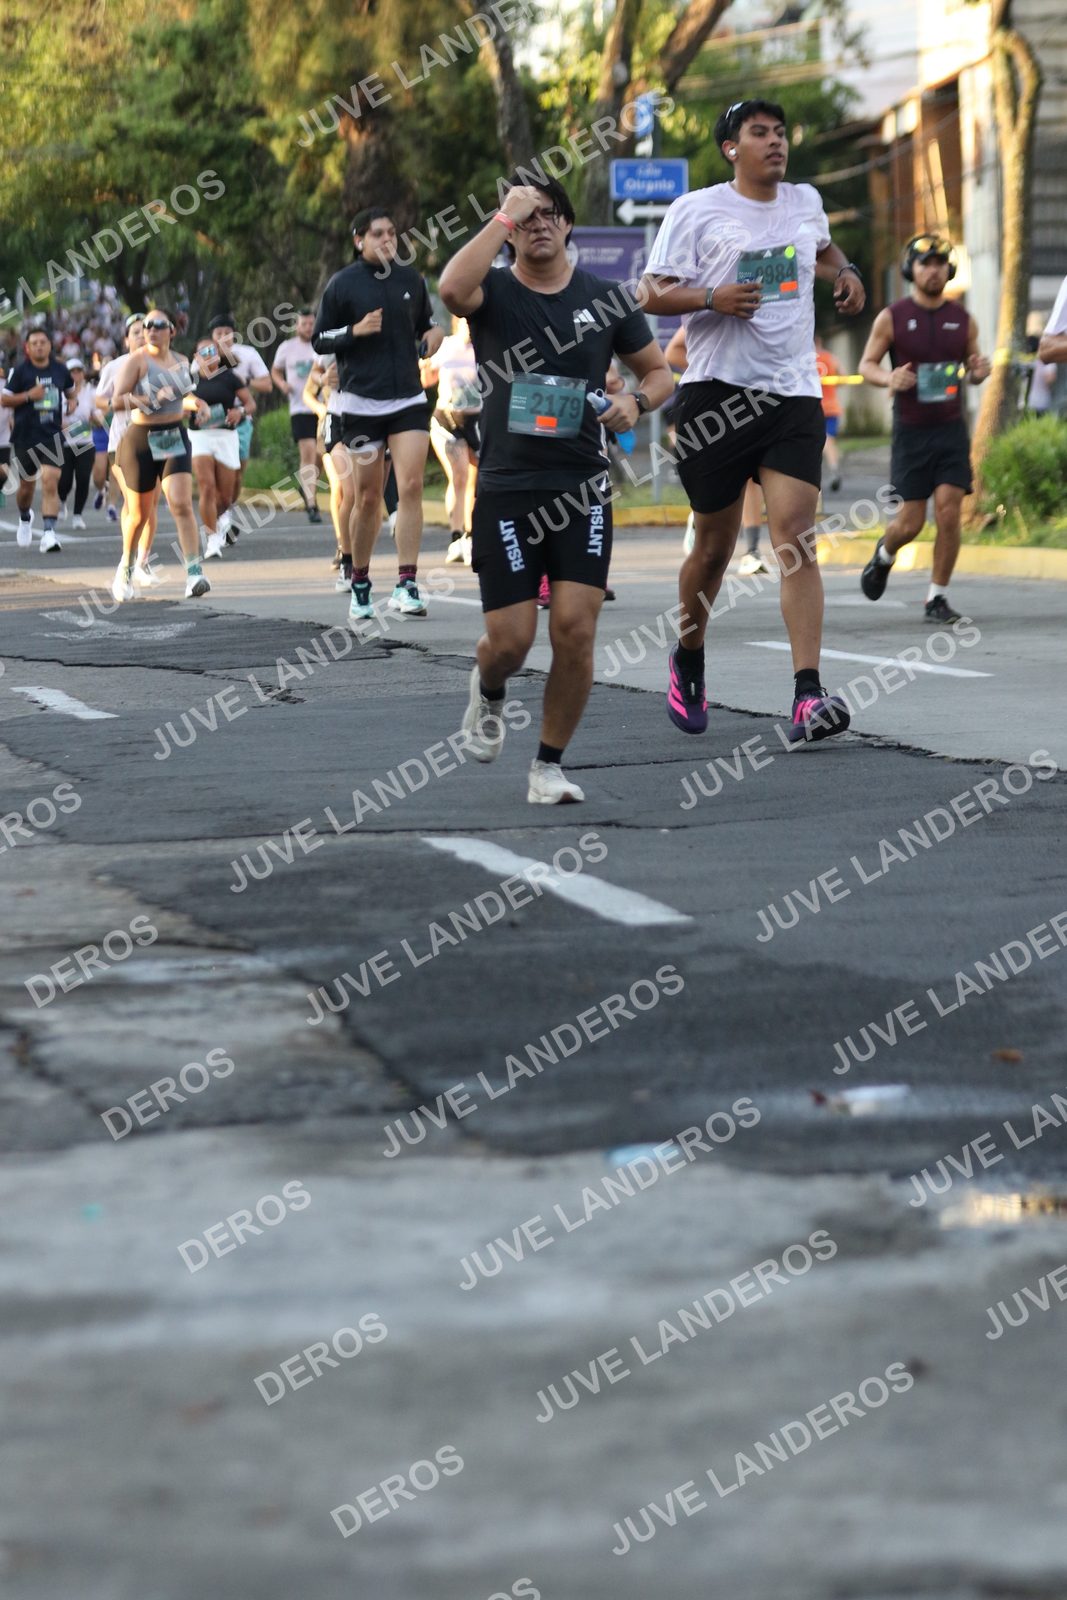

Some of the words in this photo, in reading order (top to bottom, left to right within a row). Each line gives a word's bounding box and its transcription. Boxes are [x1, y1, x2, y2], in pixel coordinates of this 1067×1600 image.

[529, 391, 581, 420] 2179
[499, 519, 525, 572] RSLNT
[587, 505, 604, 557] RSLNT
